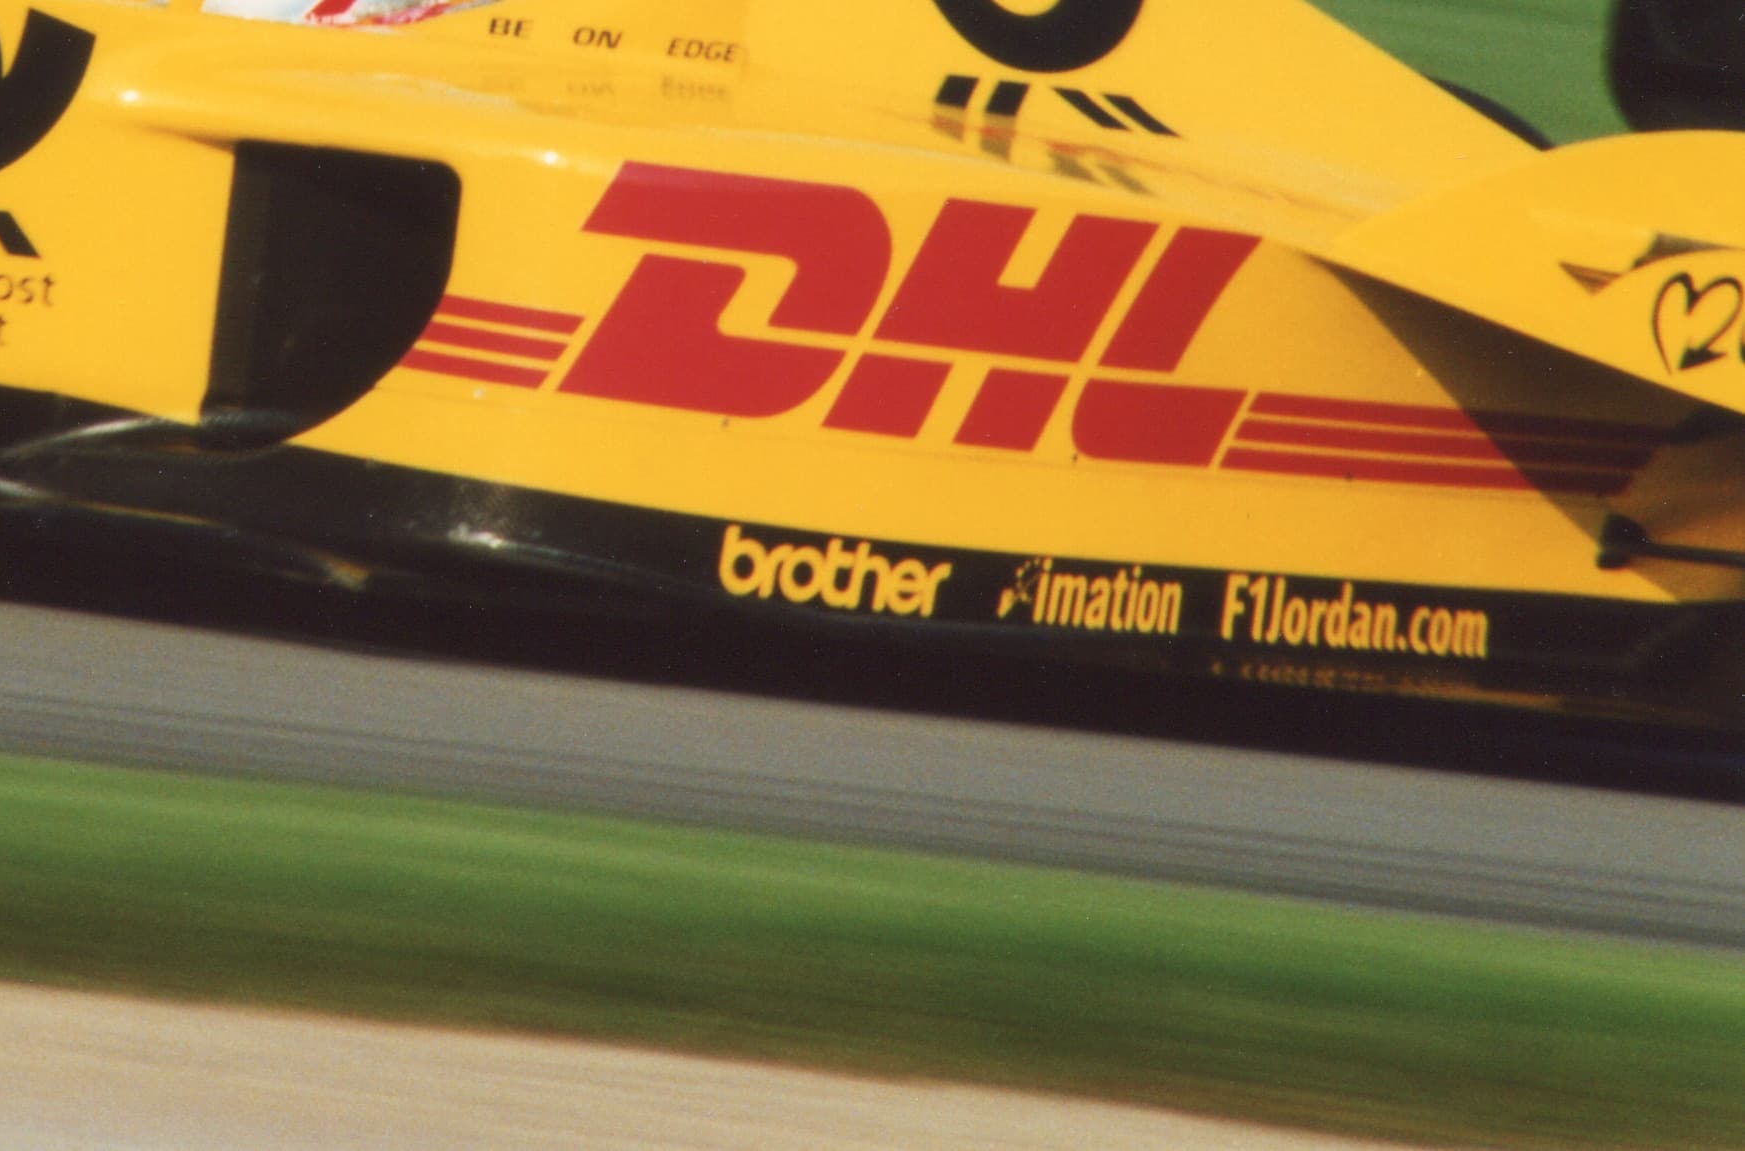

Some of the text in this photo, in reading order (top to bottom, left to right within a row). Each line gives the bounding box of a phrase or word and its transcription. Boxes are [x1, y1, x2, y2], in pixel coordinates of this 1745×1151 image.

[488, 17, 739, 64] BE ON EDGE
[556, 160, 1264, 470] DHL
[718, 525, 952, 618] brother
[1033, 559, 1181, 634] imation
[1220, 572, 1488, 660] F1Jordan.com
